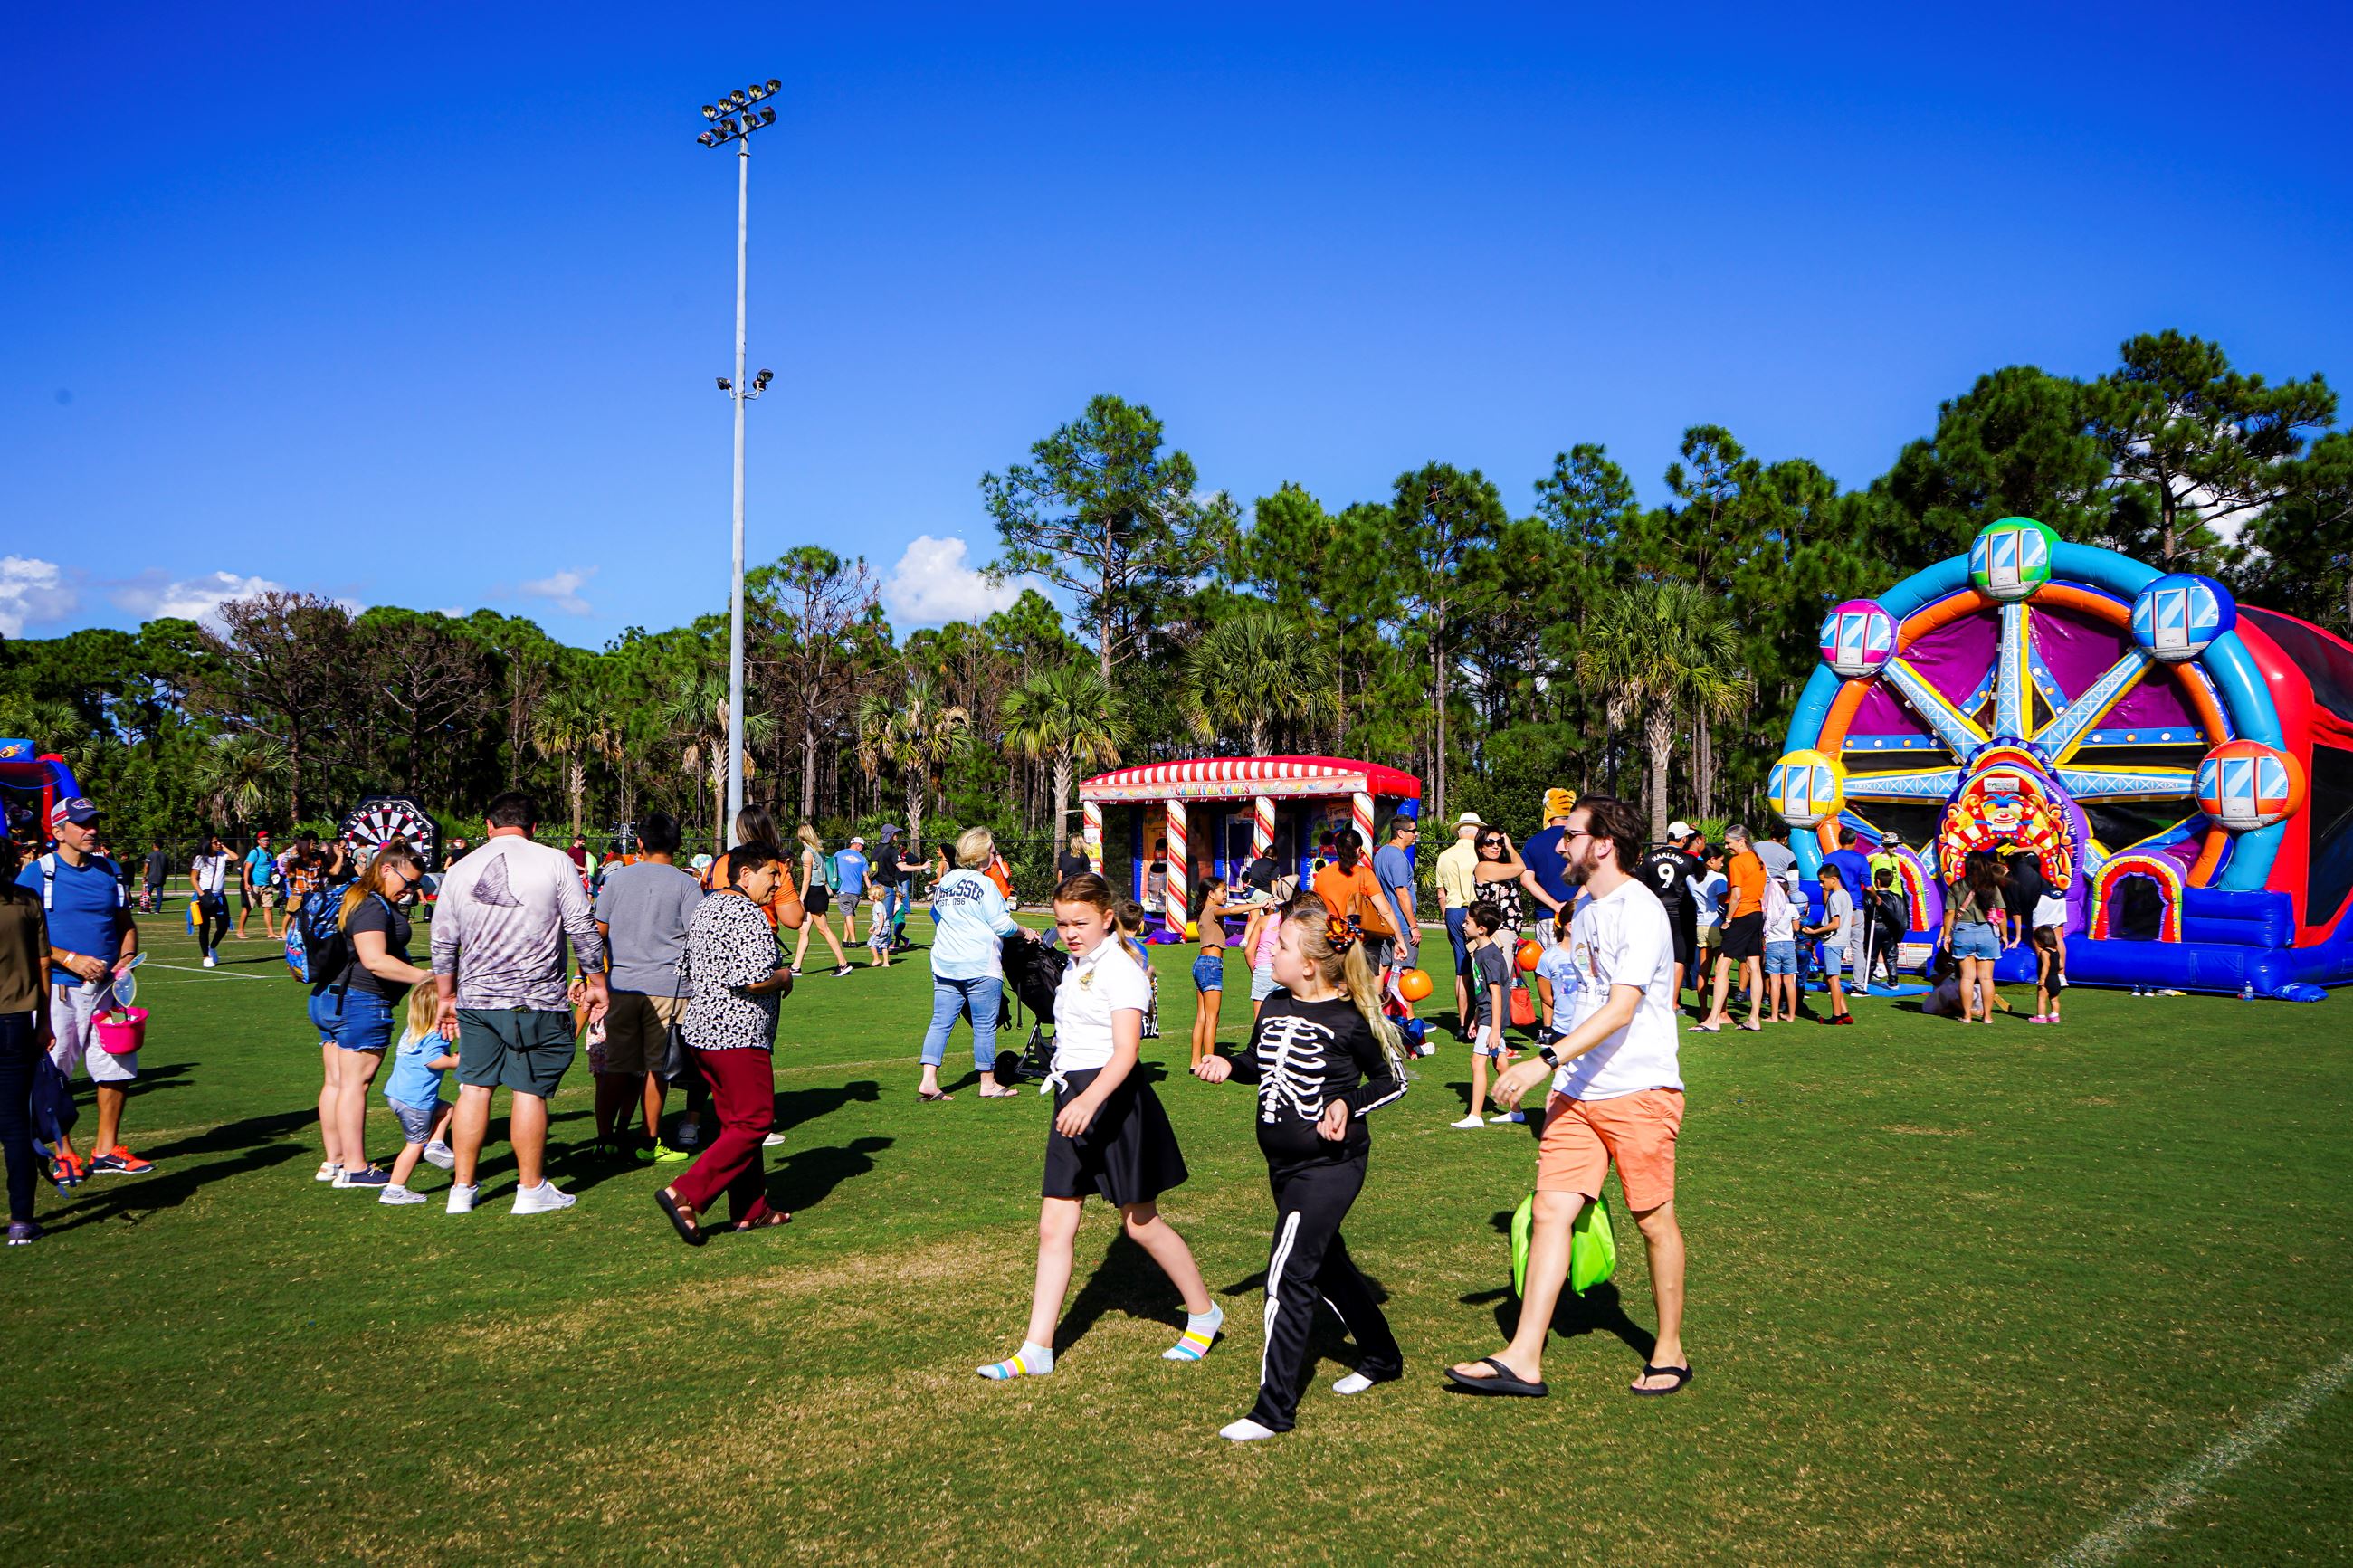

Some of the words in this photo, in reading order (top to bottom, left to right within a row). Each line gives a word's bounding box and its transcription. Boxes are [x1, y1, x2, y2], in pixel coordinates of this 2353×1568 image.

[1176, 784, 1219, 796] CARNIVAL
[1220, 783, 1250, 795] GAMES
[1651, 853, 1684, 865] HAALAND
[1658, 863, 1674, 889] 9
[952, 898, 966, 906] 1796
